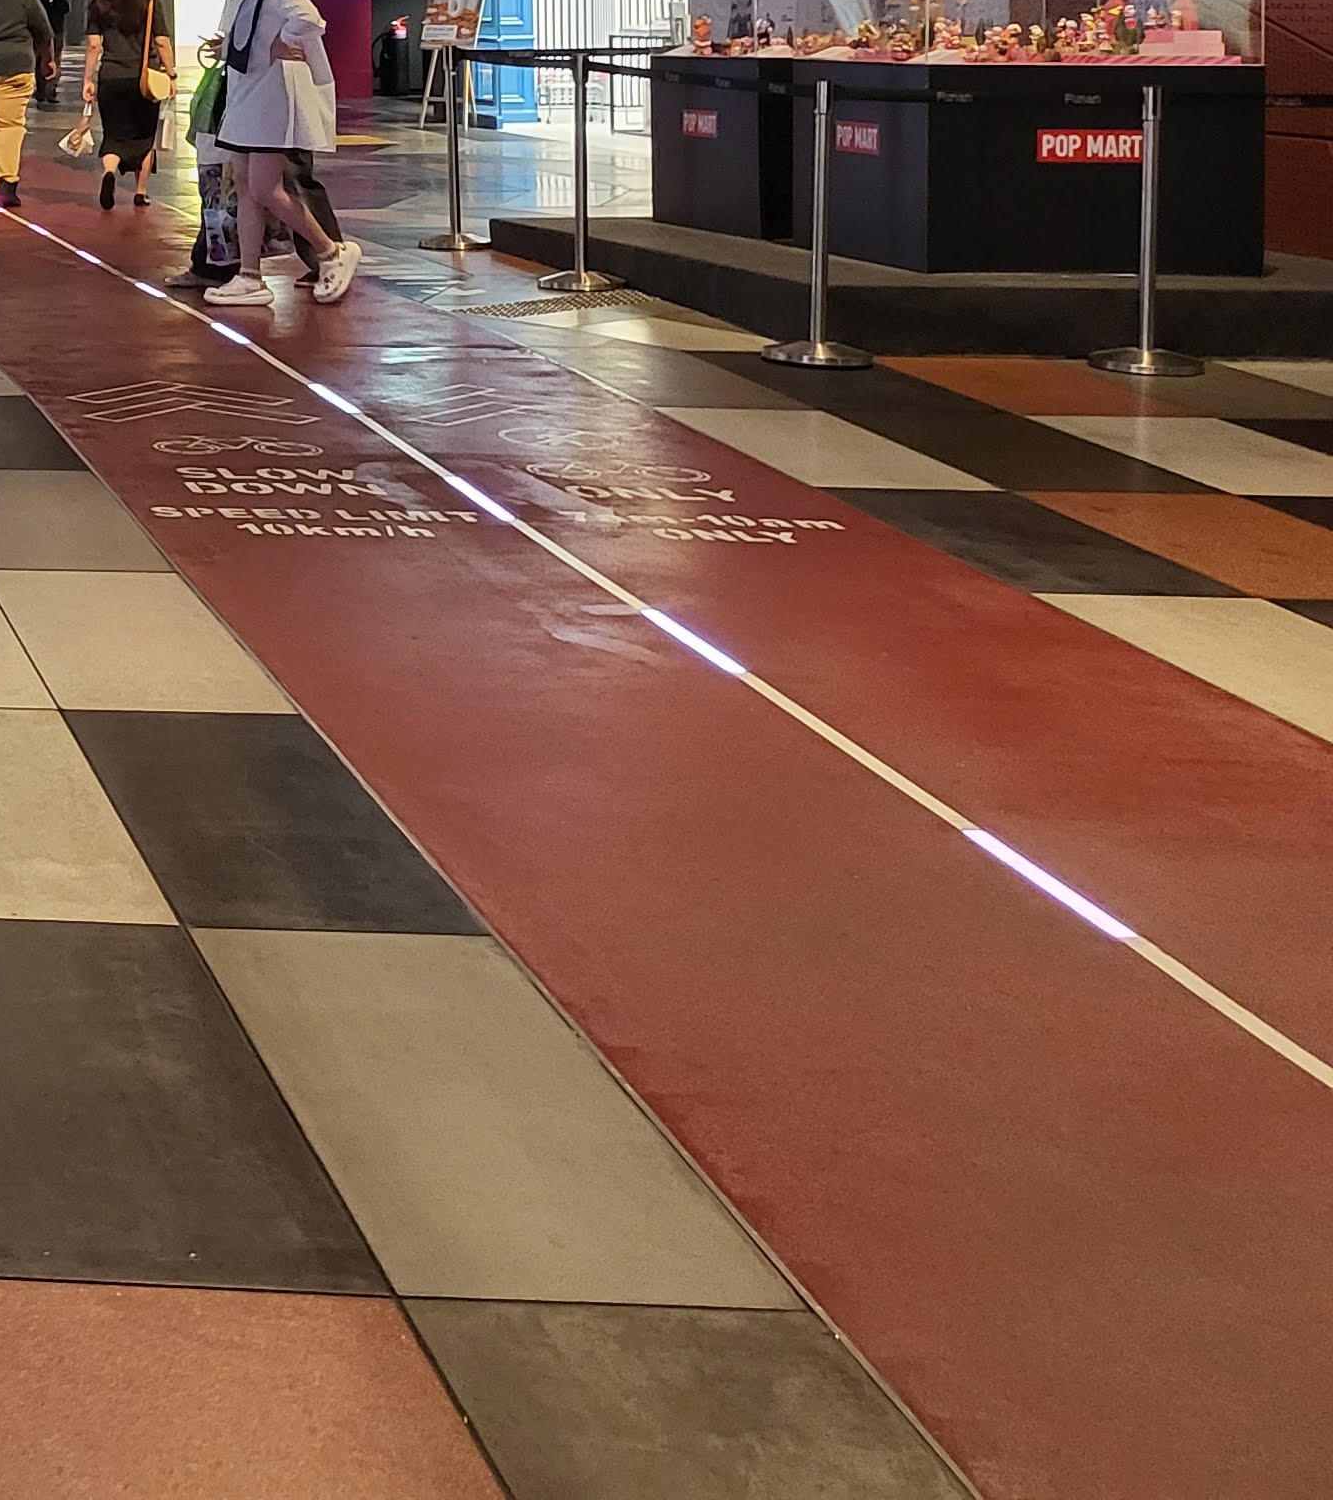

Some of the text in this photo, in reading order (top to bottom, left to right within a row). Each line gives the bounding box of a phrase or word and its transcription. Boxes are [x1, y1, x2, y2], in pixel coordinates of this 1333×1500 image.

[683, 112, 718, 135] POP MART
[836, 124, 879, 150] POP MART
[1041, 133, 1143, 159] POP MART
[175, 465, 355, 481] SLOW
[182, 480, 388, 497] DOWN
[564, 484, 736, 503] ONLY
[150, 505, 480, 524] SPEED LIMIT
[236, 521, 437, 539] 10km/h
[652, 527, 798, 545] ONLY
